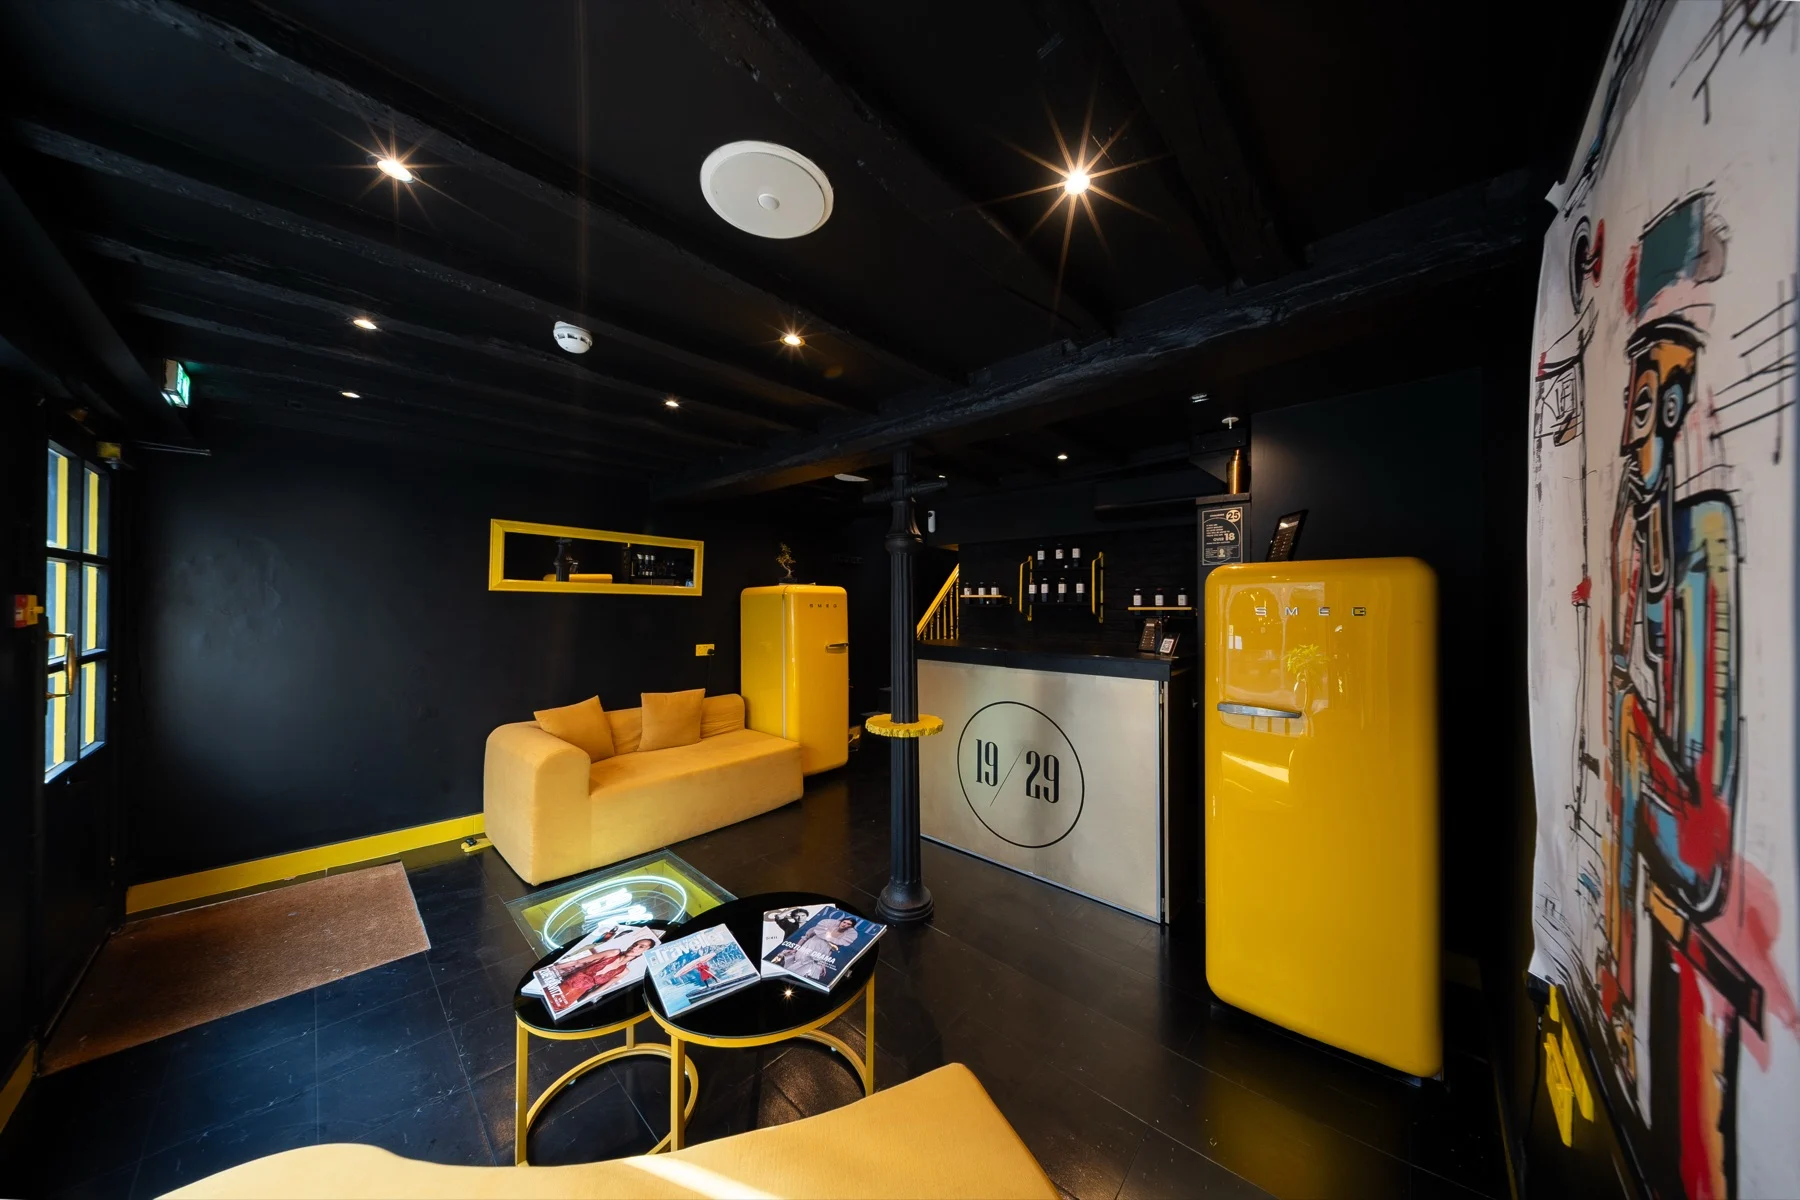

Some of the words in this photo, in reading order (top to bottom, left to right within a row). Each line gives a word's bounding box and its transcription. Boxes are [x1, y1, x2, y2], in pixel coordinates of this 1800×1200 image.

[1228, 511, 1239, 520] 25
[1224, 532, 1235, 541] 18
[1254, 606, 1367, 616] SMEG
[811, 949, 836, 965] DRAMA
